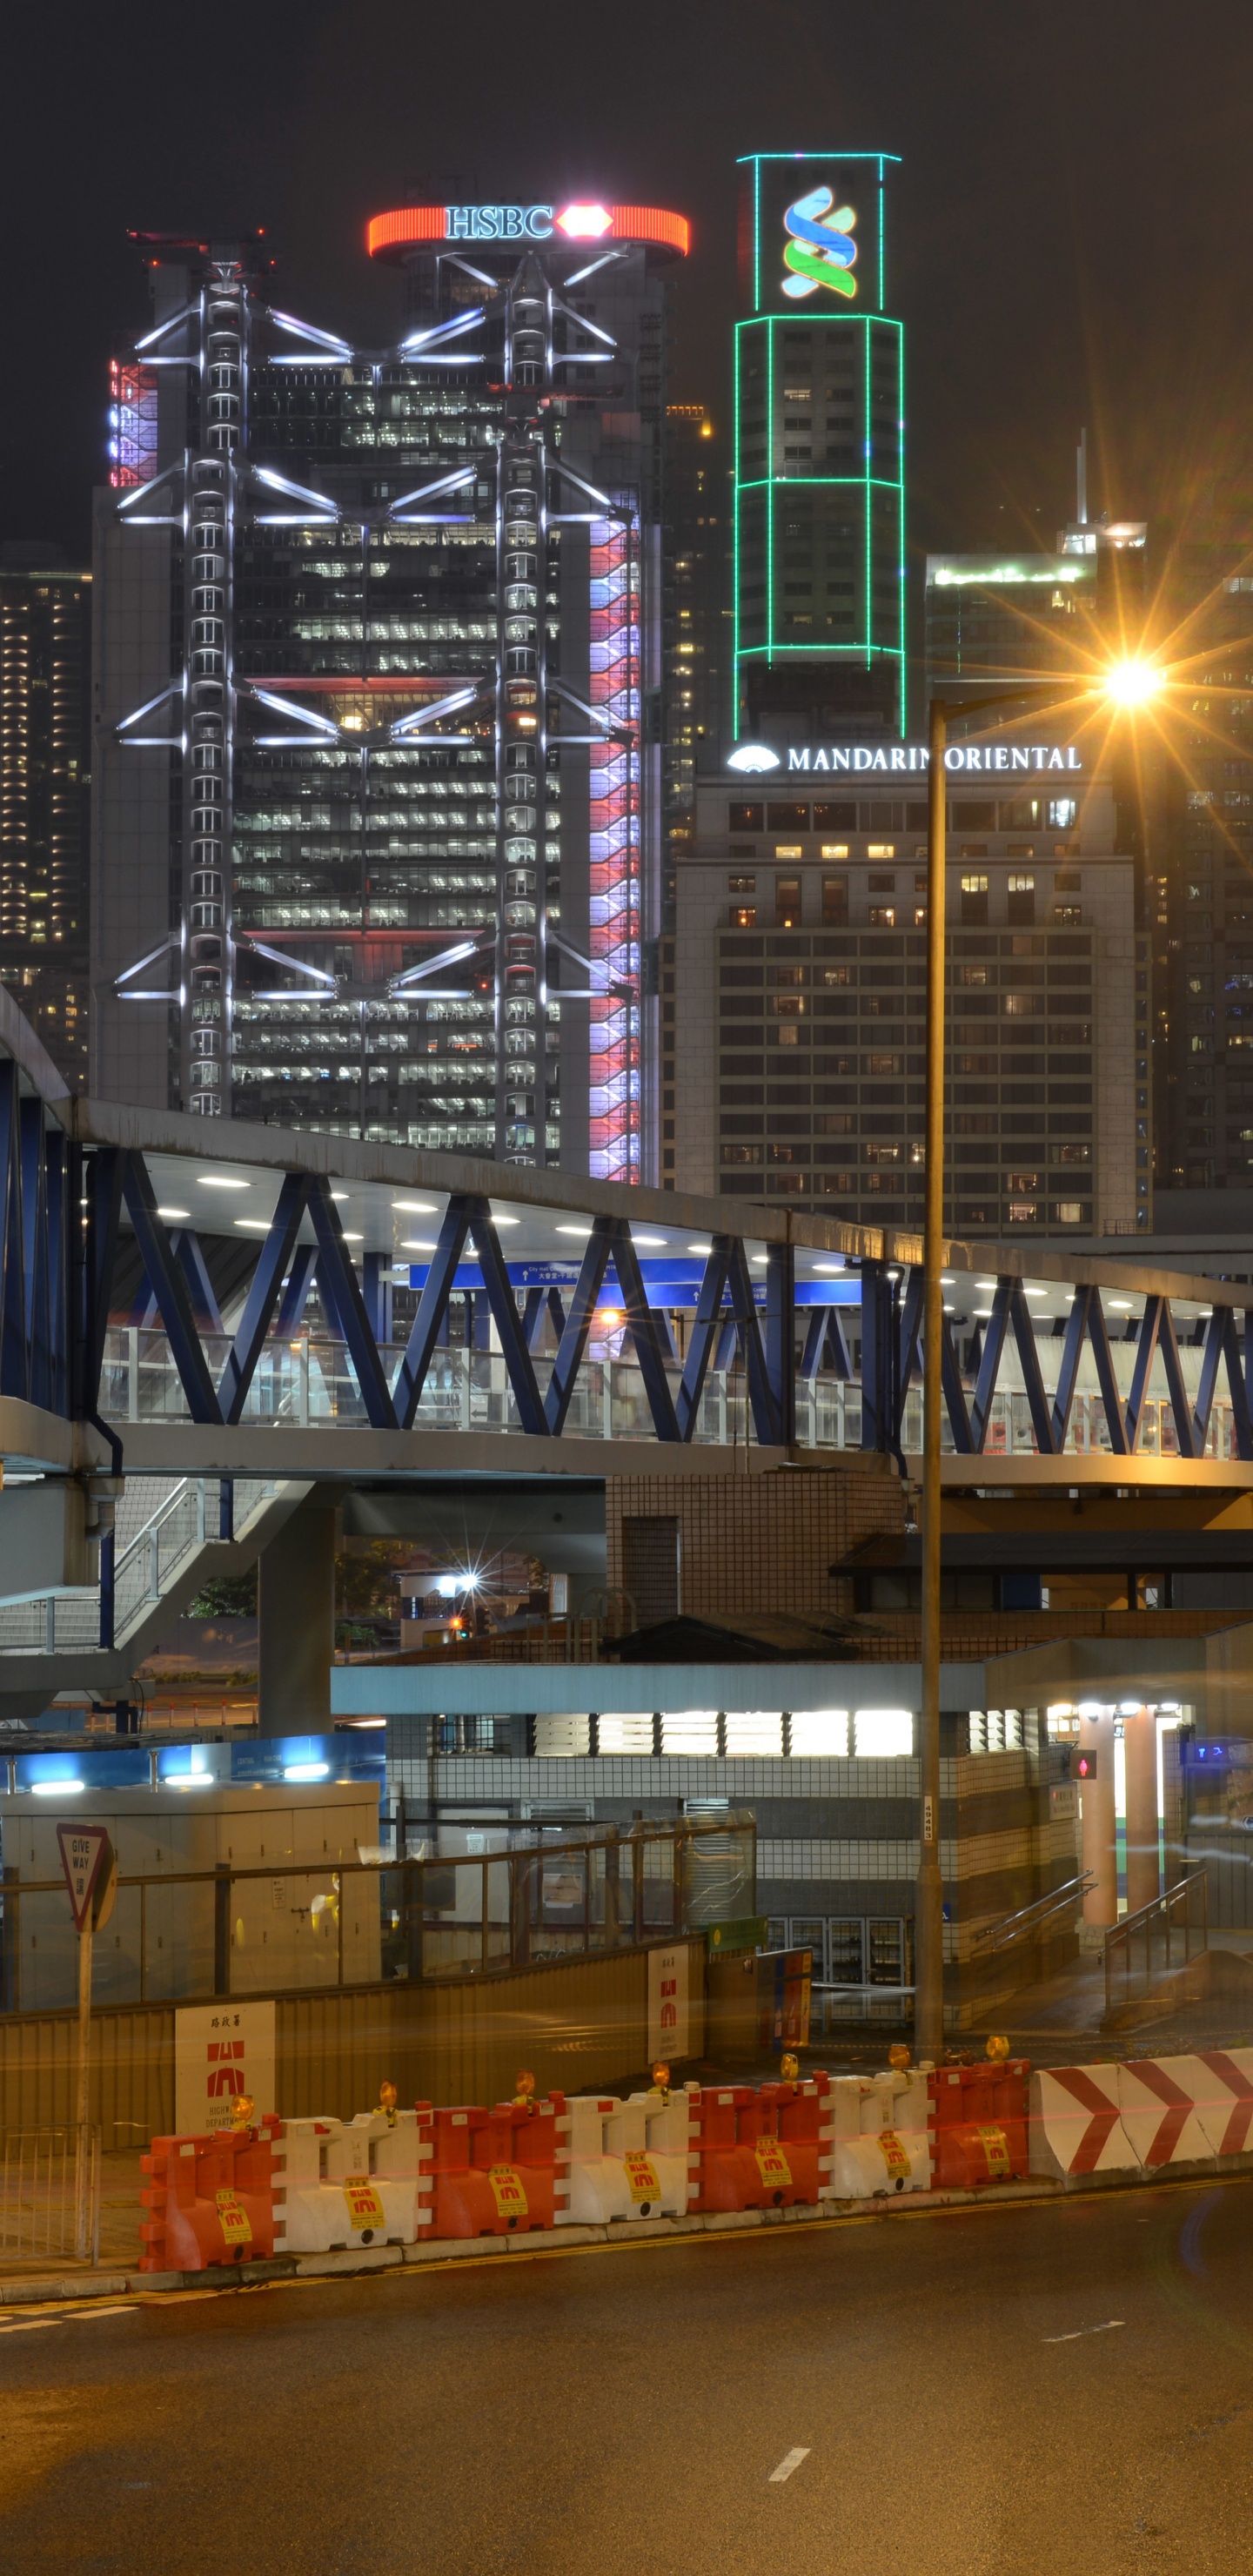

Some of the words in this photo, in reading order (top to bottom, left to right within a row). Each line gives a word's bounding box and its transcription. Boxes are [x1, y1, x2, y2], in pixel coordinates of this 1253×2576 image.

[446, 205, 553, 239] HSBC
[787, 748, 929, 770] MANDARIN
[944, 747, 1082, 769] ORIENTAL
[72, 1839, 90, 1854] GIVE
[72, 1856, 90, 1869] WAY
[211, 2014, 241, 2028] 路政署
[209, 2105, 232, 2116] HIGHW
[205, 2116, 238, 2129] DEPARTM
